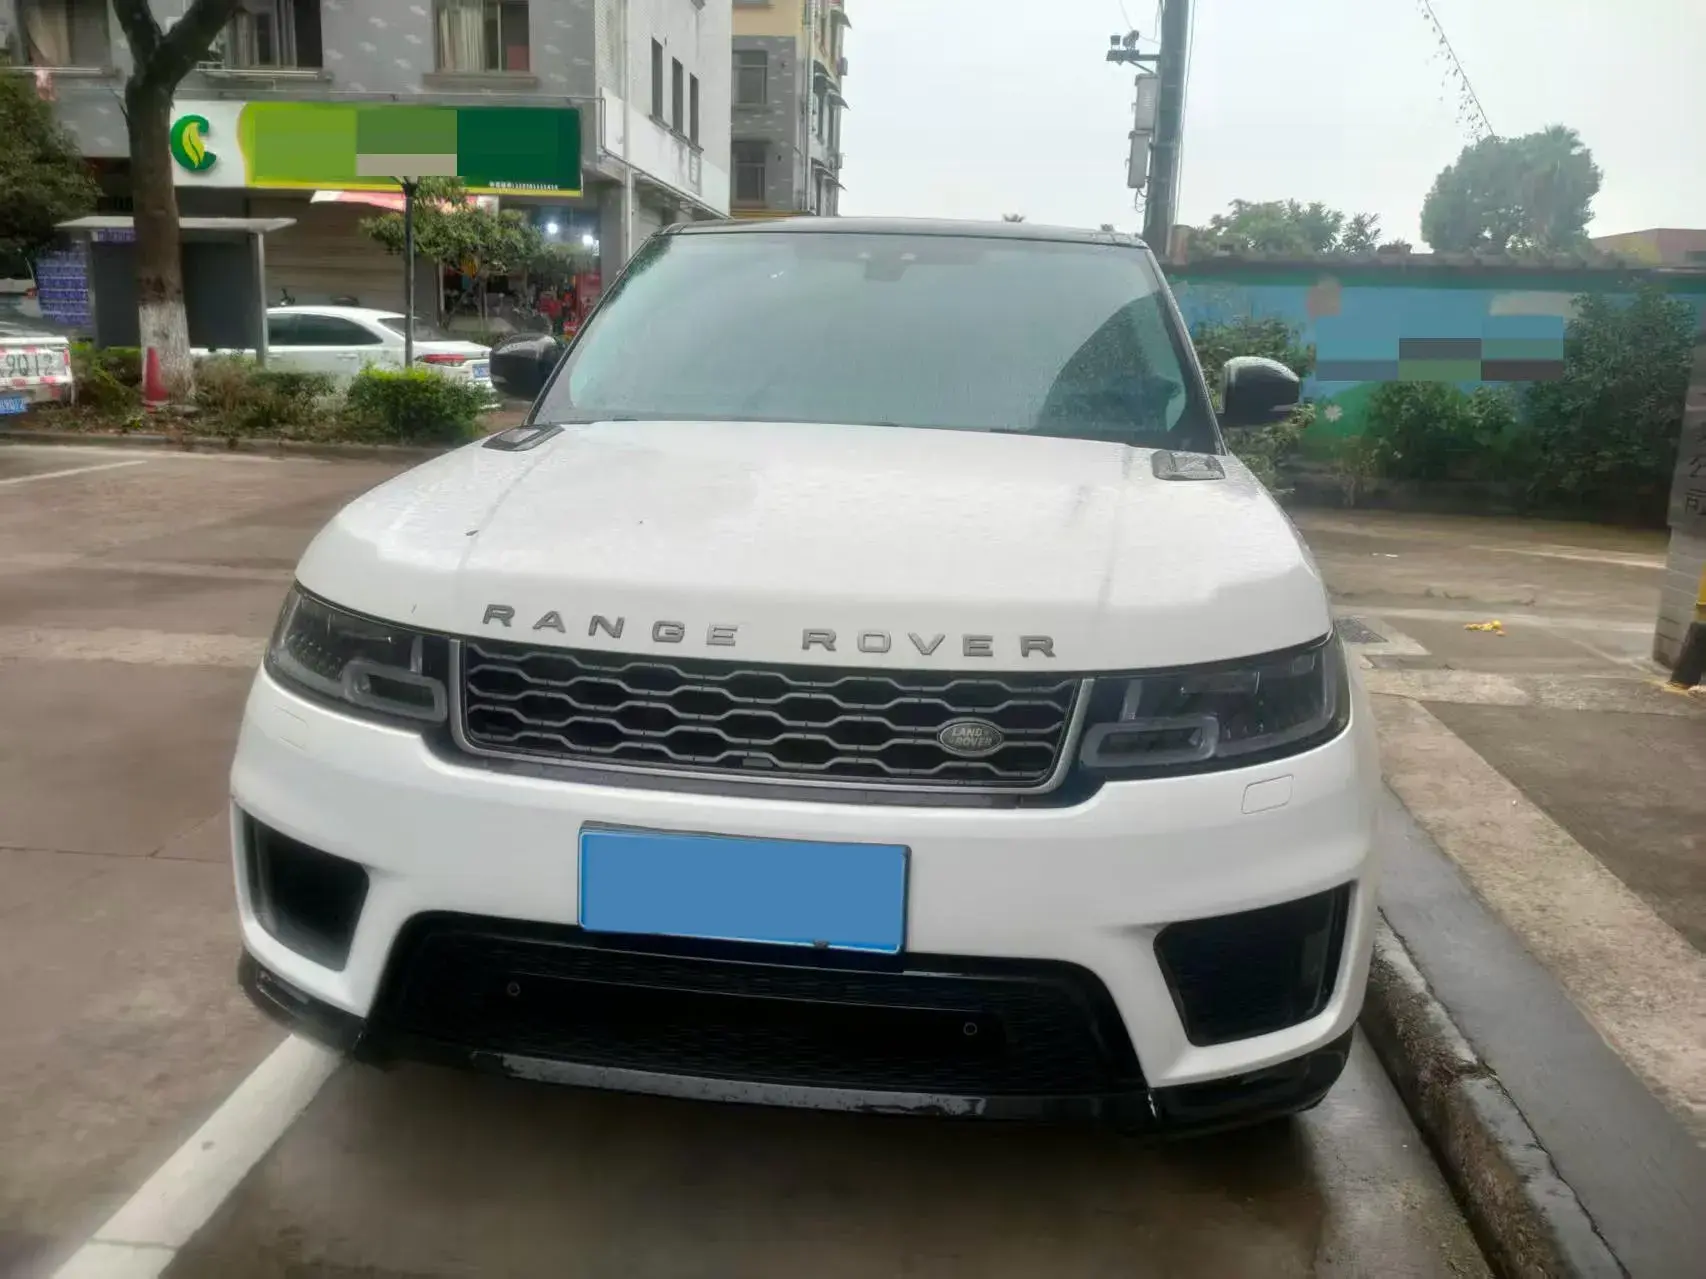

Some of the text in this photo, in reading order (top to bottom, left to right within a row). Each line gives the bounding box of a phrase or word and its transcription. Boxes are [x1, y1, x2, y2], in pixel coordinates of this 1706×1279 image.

[482, 603, 1057, 659] RANGE ROVER
[951, 727, 983, 737] LAND
[953, 736, 993, 748] ROVER
